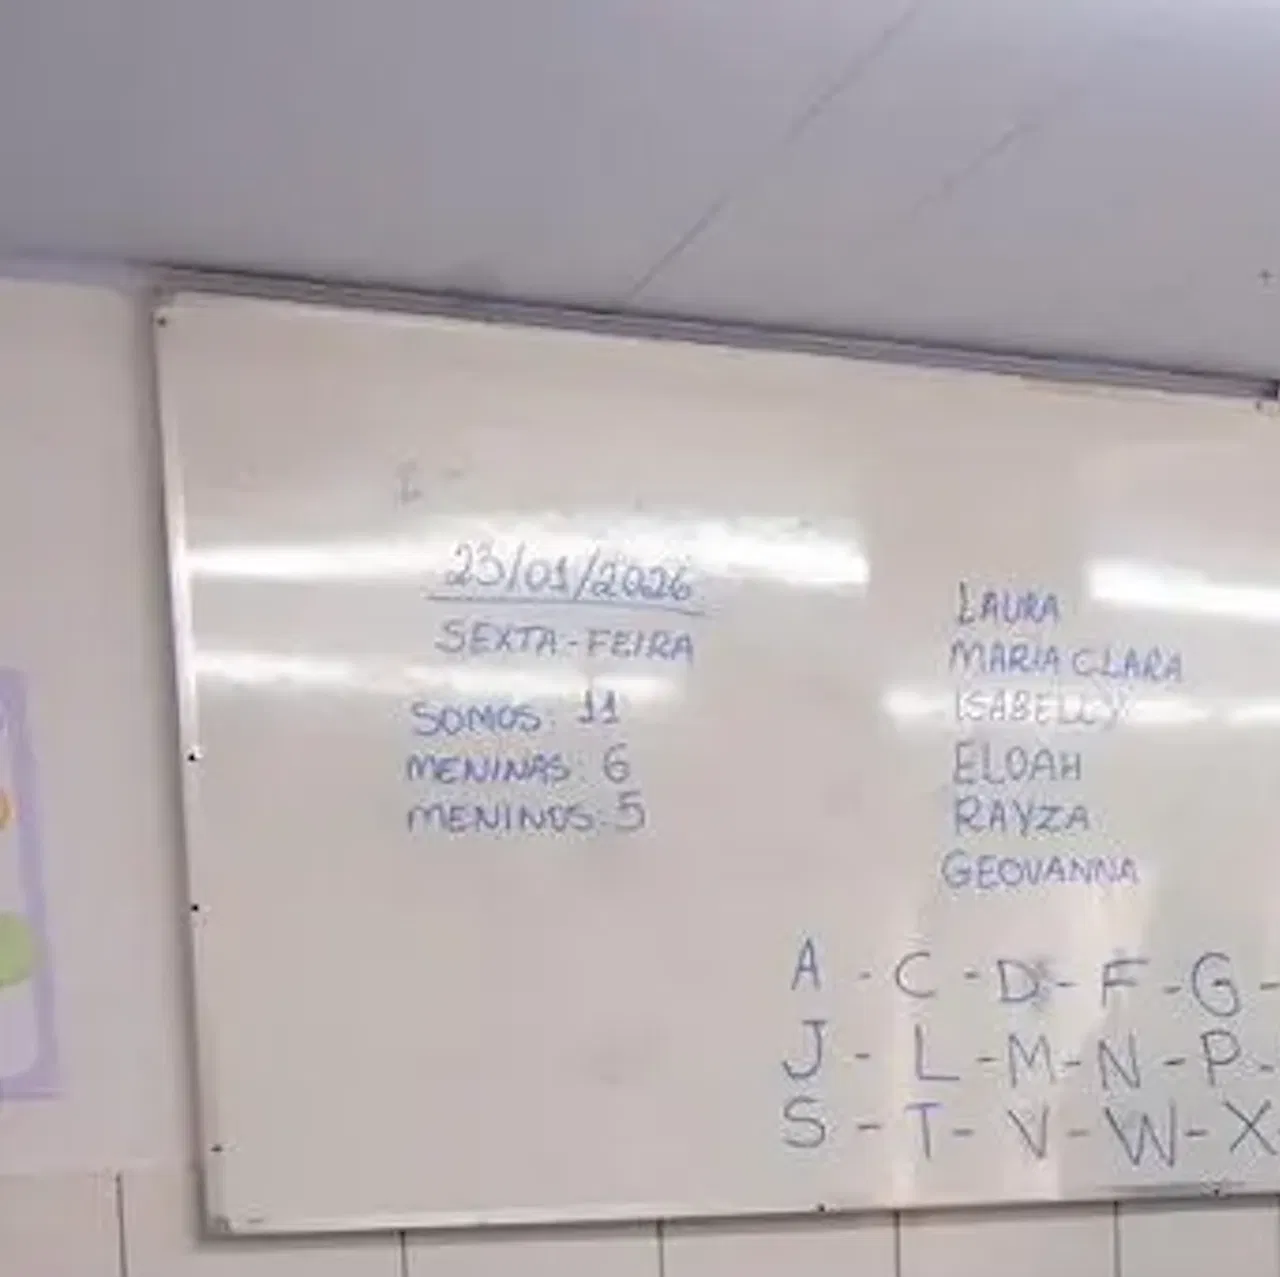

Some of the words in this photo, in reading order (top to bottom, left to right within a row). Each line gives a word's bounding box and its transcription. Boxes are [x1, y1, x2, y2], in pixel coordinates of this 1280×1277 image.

[442, 542, 692, 601] 23/01/2026
[956, 582, 1061, 626] LAURA
[949, 643, 1061, 678] MARIA
[1072, 648, 1184, 681] CLARA
[578, 689, 620, 725] 11
[603, 744, 630, 783] 6
[951, 746, 1082, 785] ELOAH
[615, 789, 647, 832] 5
[953, 798, 1089, 835] RAYZA
[941, 852, 1141, 889] GEOVANNA
